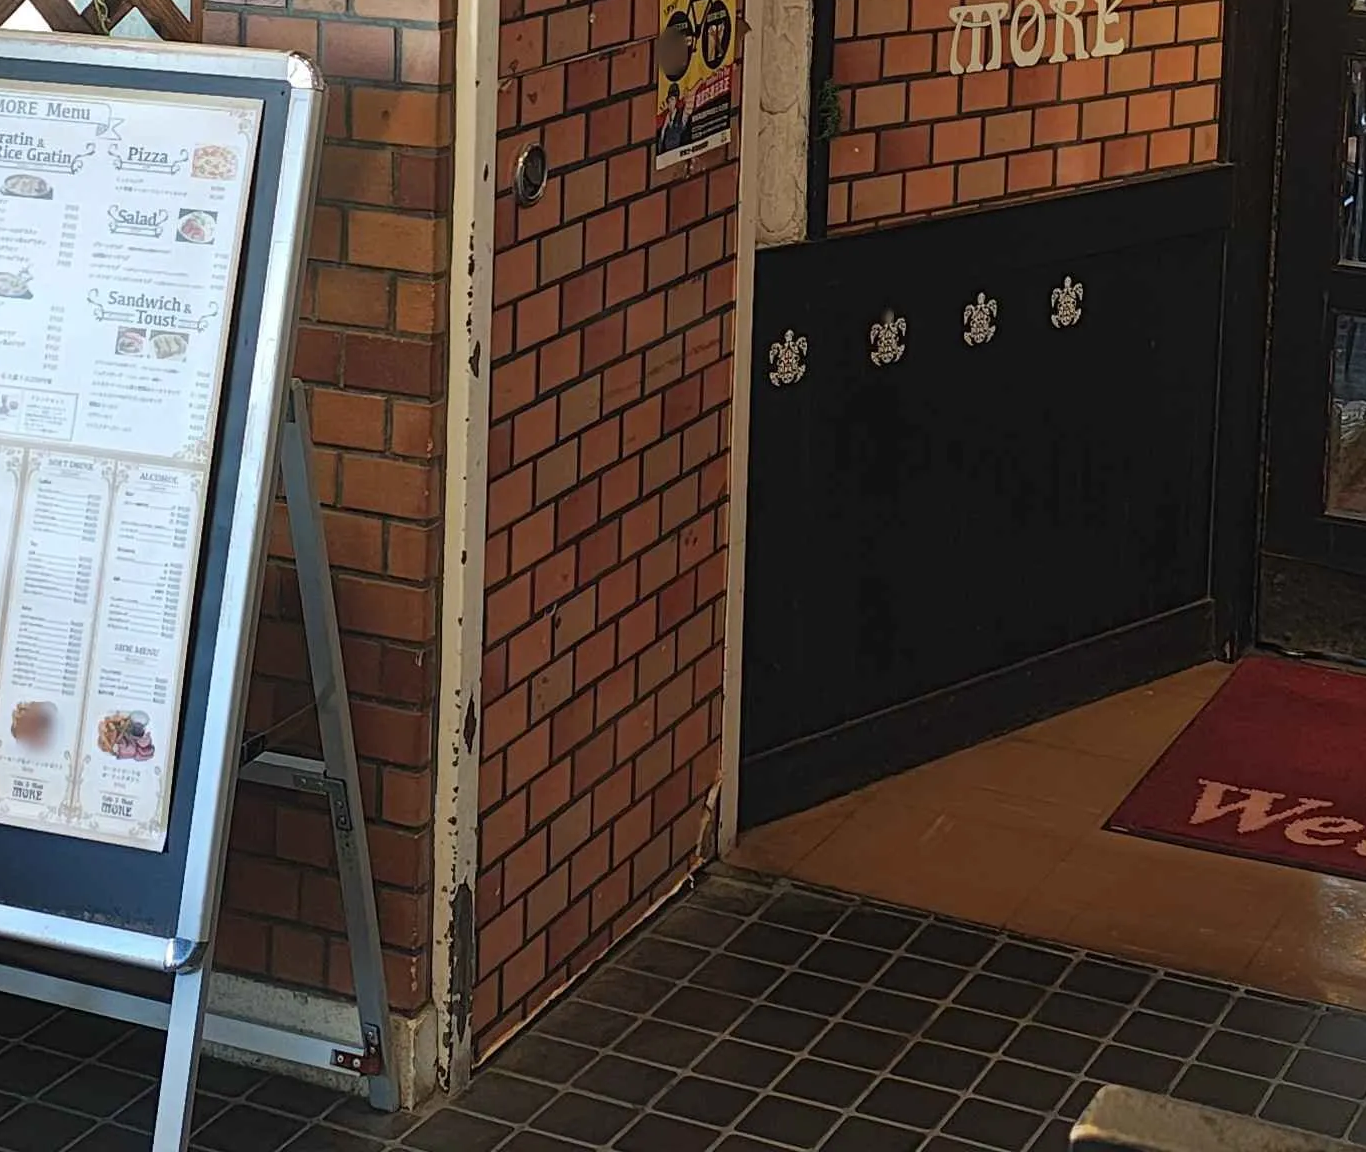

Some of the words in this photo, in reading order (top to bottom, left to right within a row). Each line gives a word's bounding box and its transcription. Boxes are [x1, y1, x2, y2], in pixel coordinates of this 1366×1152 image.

[46, 102, 91, 121] Menu
[36, 137, 45, 148] &
[26, 147, 72, 165] Gratin
[127, 146, 169, 164] Pizza
[118, 209, 158, 226] Salad
[108, 290, 182, 313] Sandwich
[183, 302, 192, 314] &
[136, 309, 178, 328] Toust
